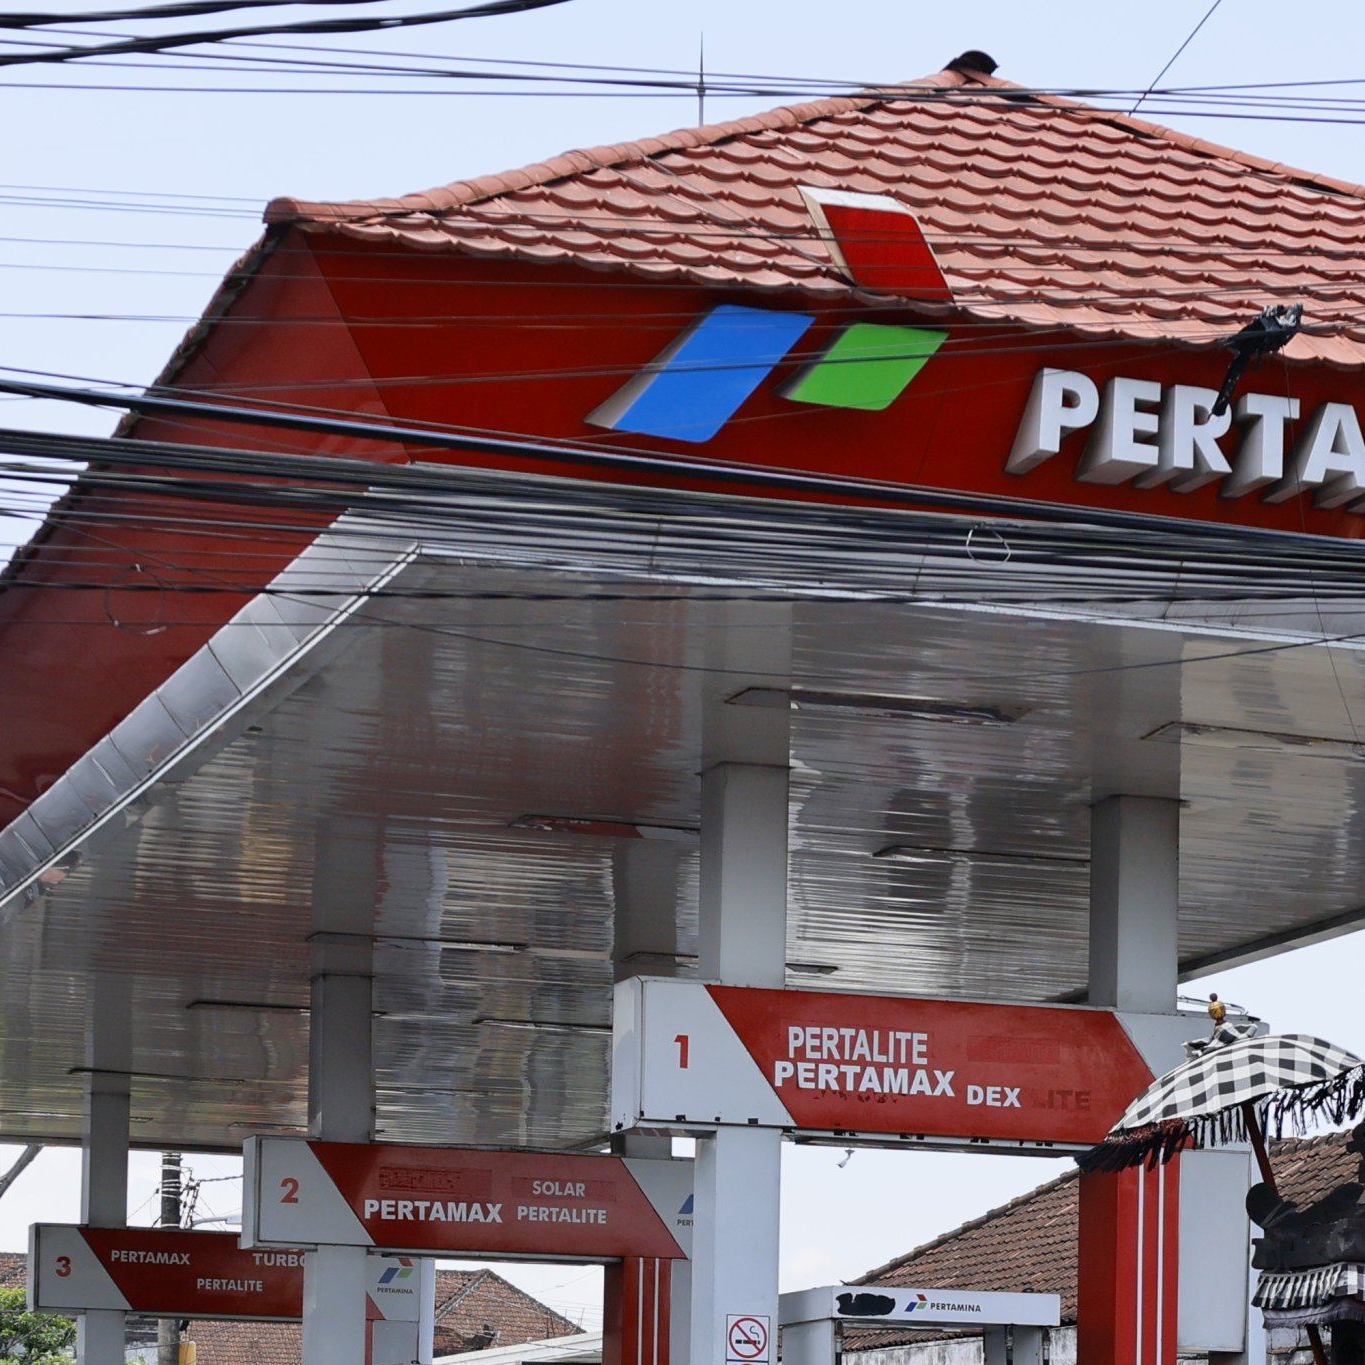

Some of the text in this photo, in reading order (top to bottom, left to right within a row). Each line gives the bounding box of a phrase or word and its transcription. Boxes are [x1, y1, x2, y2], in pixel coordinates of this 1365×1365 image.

[674, 1035, 688, 1068] 1
[788, 1025, 928, 1065] PERTALITE
[775, 1060, 955, 1097] PERTAMAX
[967, 1084, 1021, 1108] DEX
[281, 1178, 298, 1203] 2
[532, 1180, 585, 1197] SOLAR
[364, 1200, 606, 1225] PERTAMAX PERTALITE
[55, 1256, 71, 1278] 3
[110, 1249, 190, 1266] PERTAMAX
[196, 1277, 263, 1293] PERTALITE
[377, 1287, 413, 1295] PERTAMINA
[930, 1301, 982, 1313] PERTAMINA
